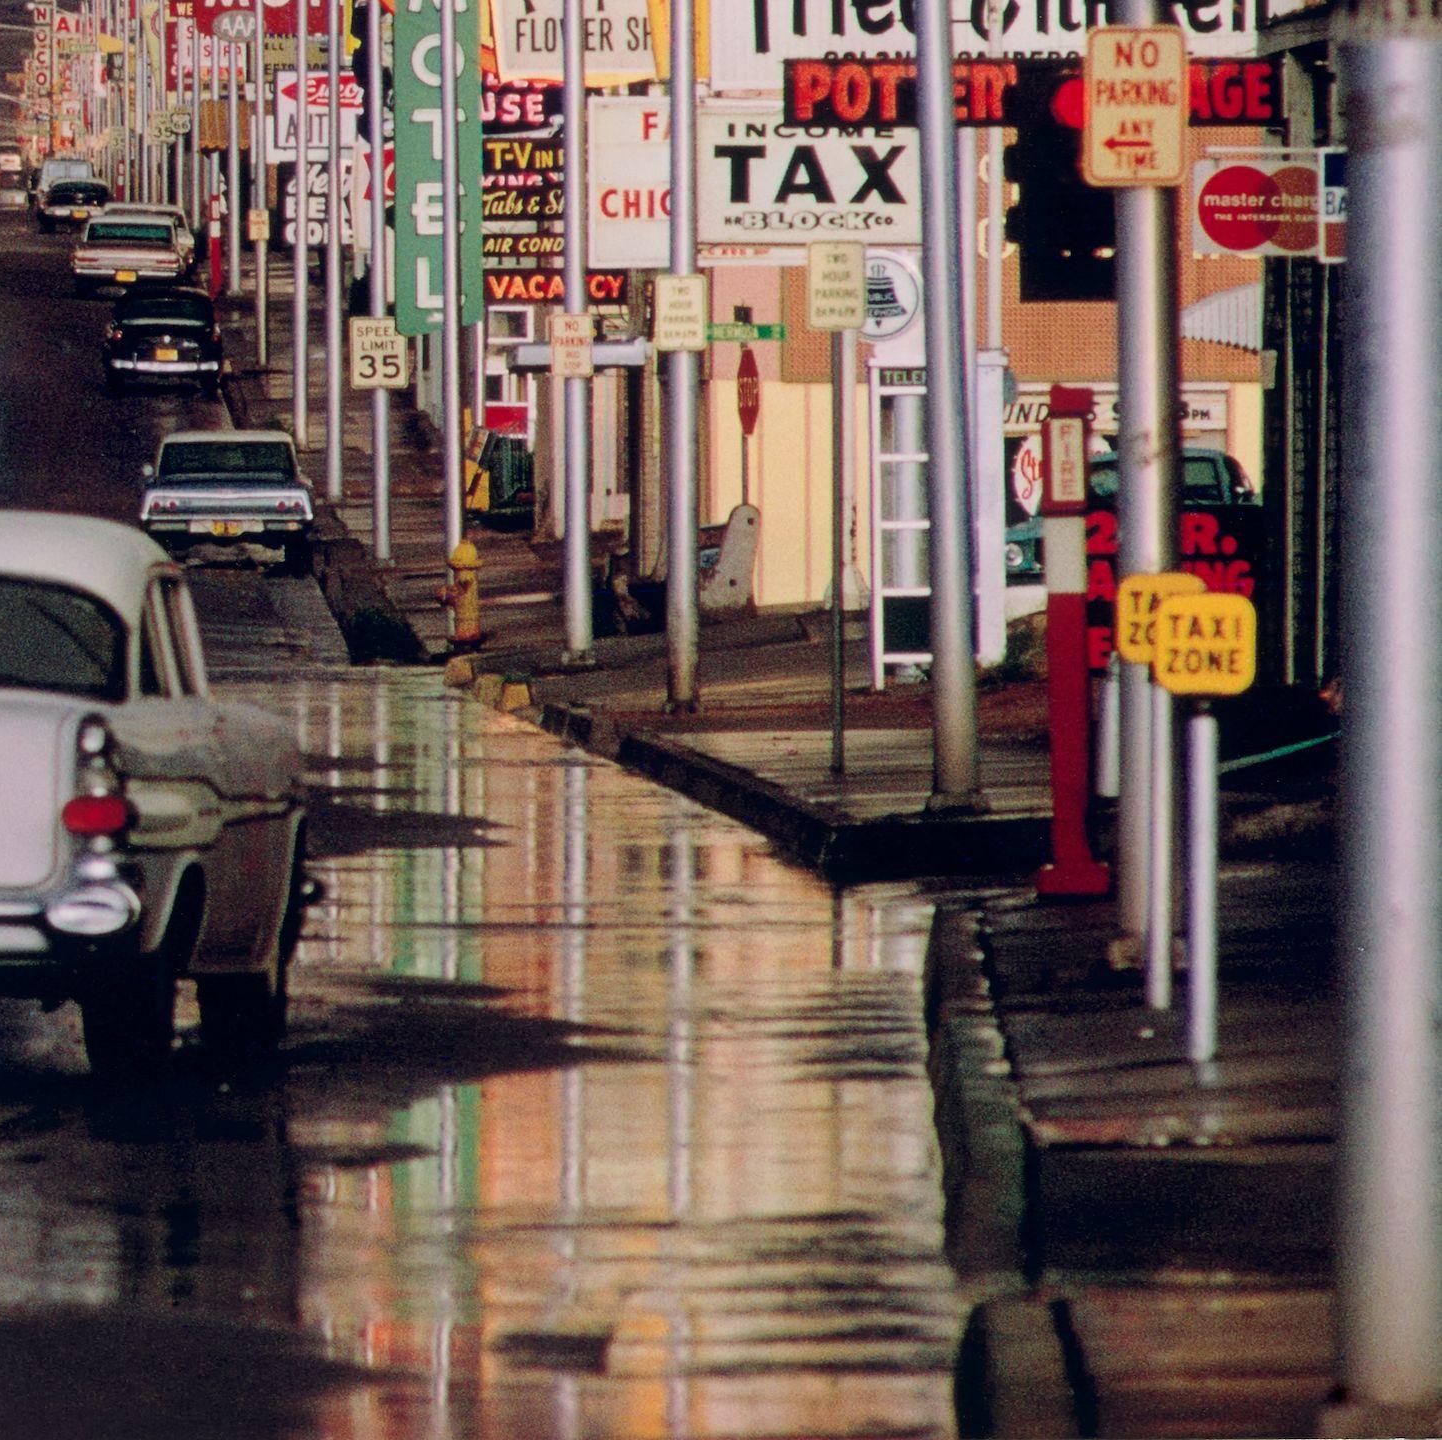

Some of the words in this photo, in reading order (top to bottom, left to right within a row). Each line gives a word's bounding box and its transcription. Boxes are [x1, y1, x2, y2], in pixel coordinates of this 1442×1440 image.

[515, 17, 614, 53] FLOER
[1115, 41, 1159, 68] NO
[1096, 78, 1178, 107] PARKING
[727, 123, 895, 140] INCOME
[1118, 119, 1156, 140] ANY
[535, 149, 554, 170] IN
[1113, 149, 1159, 171] TIME
[713, 144, 907, 204] TAX
[482, 190, 524, 217] Tubs
[527, 192, 540, 216] &
[1203, 192, 1266, 208] master
[741, 211, 876, 231] BLOCK
[483, 236, 513, 254] AIR
[825, 253, 847, 264] TWO
[821, 270, 850, 282] HOUR
[486, 274, 626, 300] VACACY
[815, 288, 859, 300] PARKING
[356, 326, 398, 338] SPEE
[564, 320, 580, 332] NO
[360, 340, 396, 351] LIMIT
[359, 355, 401, 380] 35
[883, 369, 927, 385] TELE
[737, 376, 758, 408] STOP
[1058, 423, 1076, 495] FIRE
[1168, 613, 1243, 642] TAXI
[1166, 648, 1241, 675] ZONE
